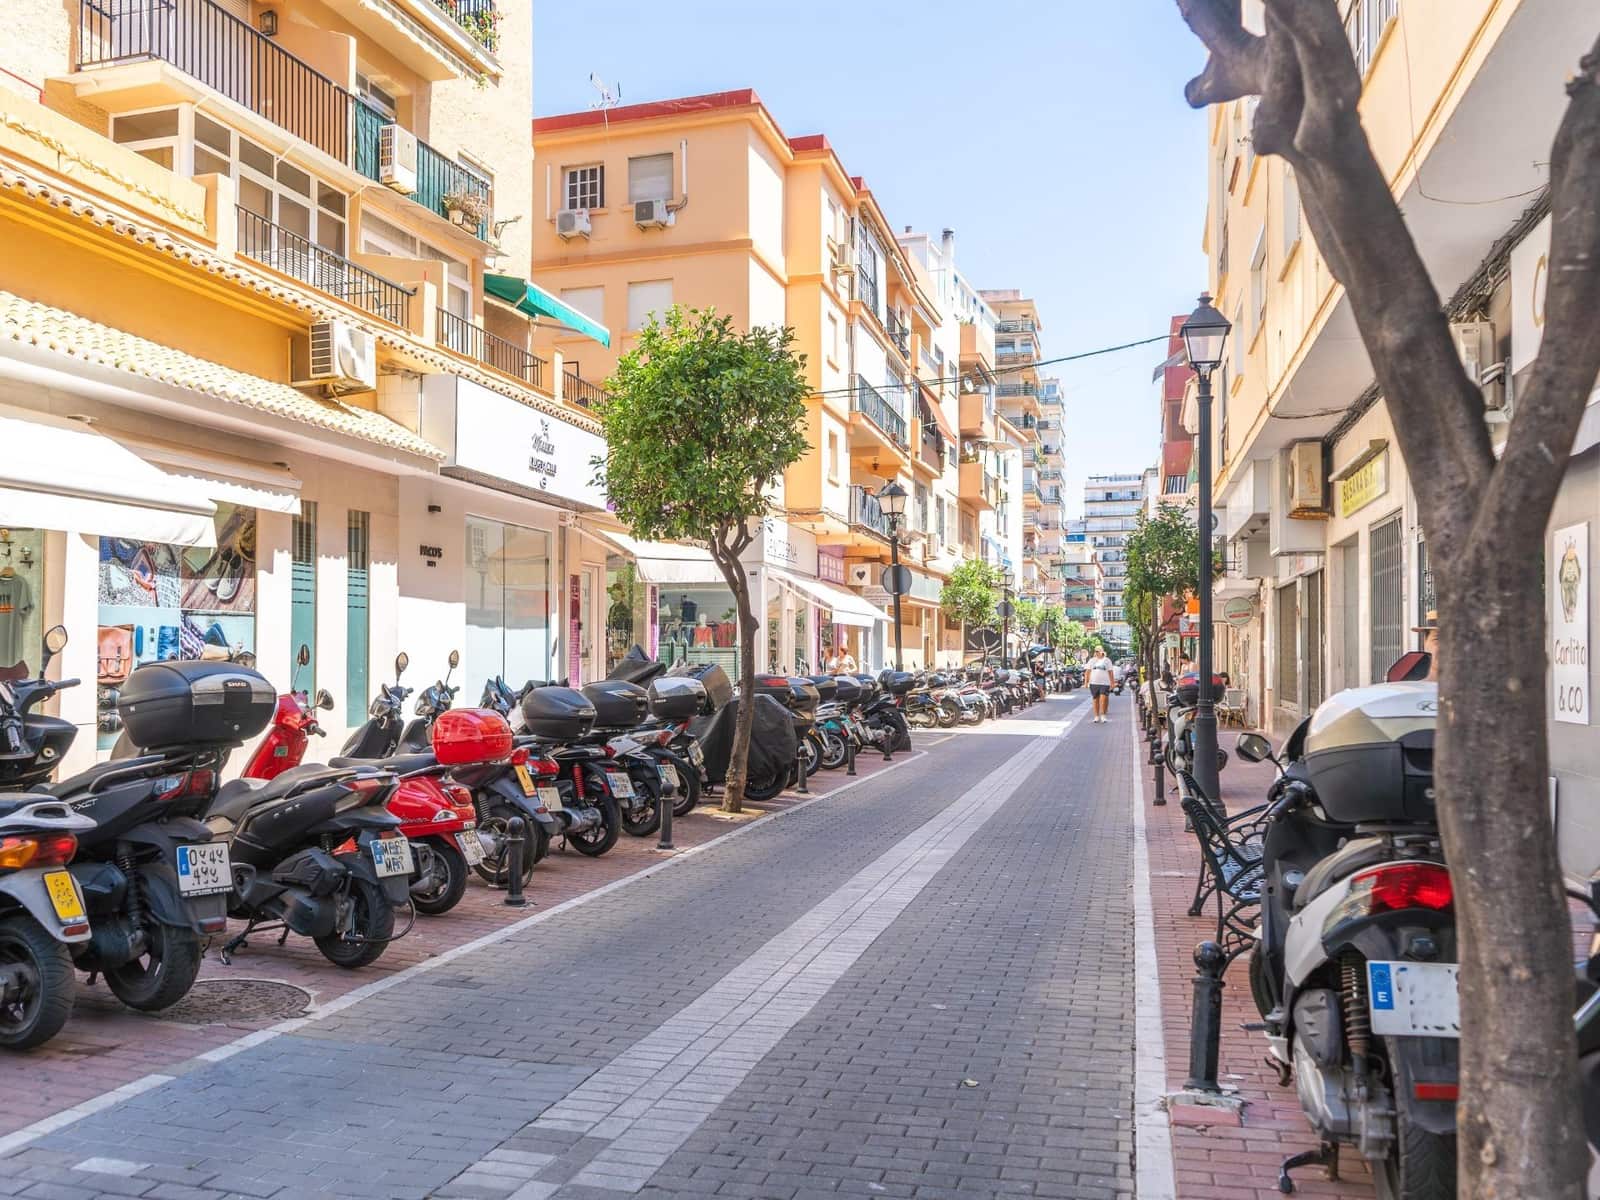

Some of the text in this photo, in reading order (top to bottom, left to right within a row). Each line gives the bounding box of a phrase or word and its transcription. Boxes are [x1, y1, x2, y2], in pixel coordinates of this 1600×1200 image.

[1559, 685, 1583, 714] & CO
[1377, 991, 1389, 1003] E
